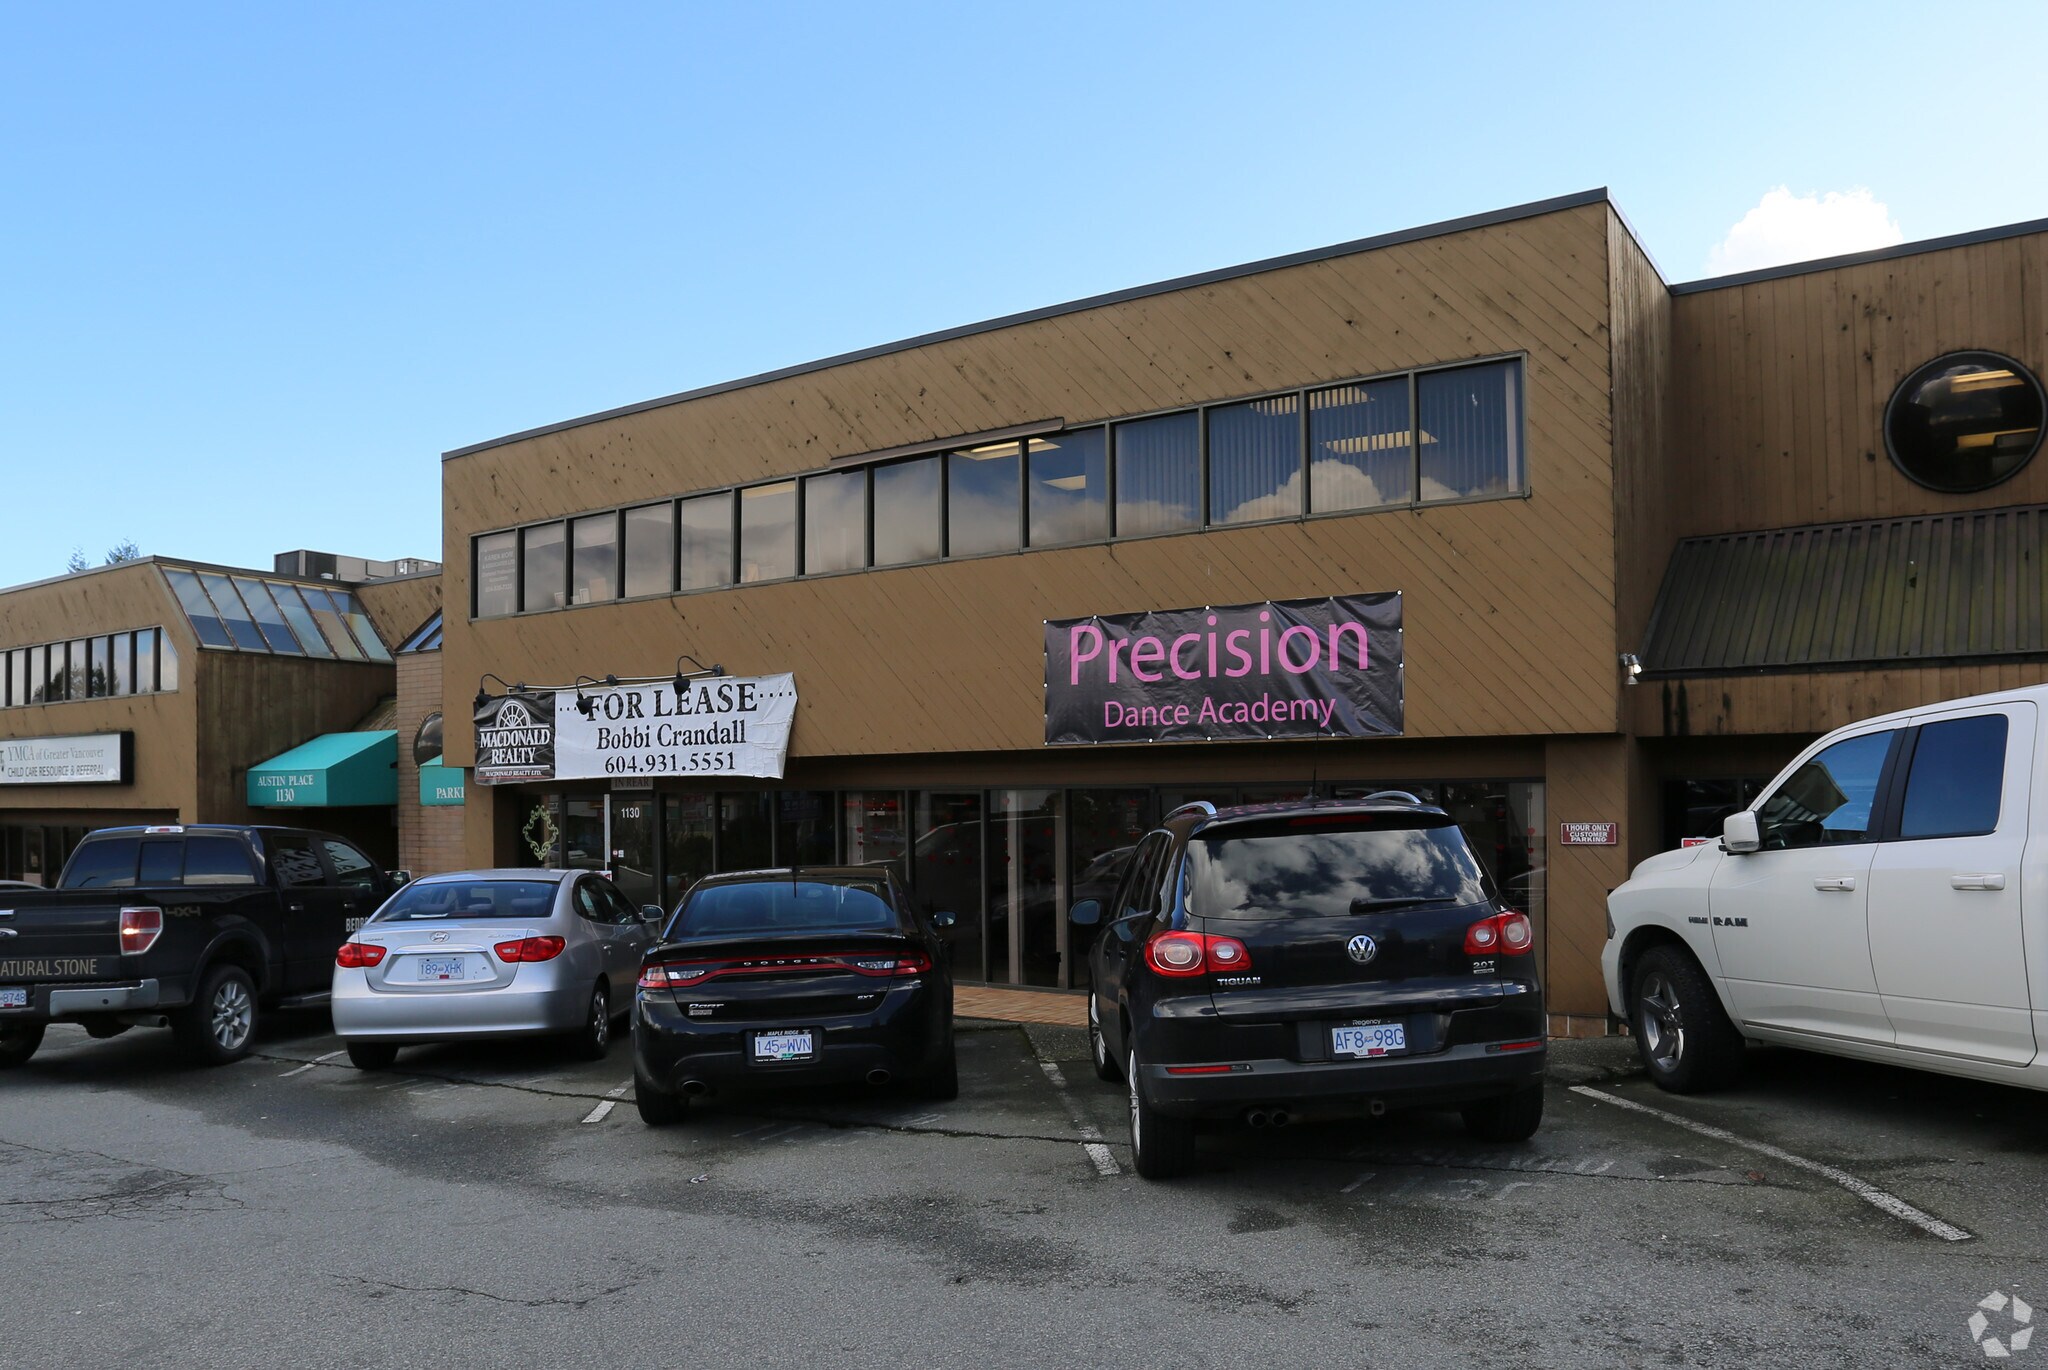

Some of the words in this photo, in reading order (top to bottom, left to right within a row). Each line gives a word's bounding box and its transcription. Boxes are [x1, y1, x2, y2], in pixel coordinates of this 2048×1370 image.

[1070, 611, 1369, 685] Precision
[586, 691, 644, 721] FOR
[653, 683, 758, 717] LEASE
[1105, 701, 1189, 727] Dance
[1198, 692, 1336, 728] Academy
[480, 729, 550, 748] MACDONALD
[596, 725, 651, 750] Bobbi
[657, 719, 746, 747] Crandall
[8, 745, 35, 761] YMCA
[43, 748, 69, 760] Greater
[70, 747, 104, 759] Vancouver
[491, 747, 536, 764] REALTY
[8, 767, 24, 777] CHILD
[25, 766, 38, 777] CARE
[39, 765, 69, 777] RESOURCE
[70, 765, 75, 776] &
[76, 764, 104, 775] REFERRAL
[605, 751, 736, 774] 604.931.5551
[258, 776, 286, 787] AUSTIN
[288, 774, 314, 786] PLACE
[276, 788, 295, 802] 1130
[621, 807, 640, 818] 1130
[1713, 916, 1748, 927] RAM
[54, 958, 98, 975] STONE
[1217, 976, 1261, 986] TIGUAN
[1352, 1018, 1381, 1026] Regency
